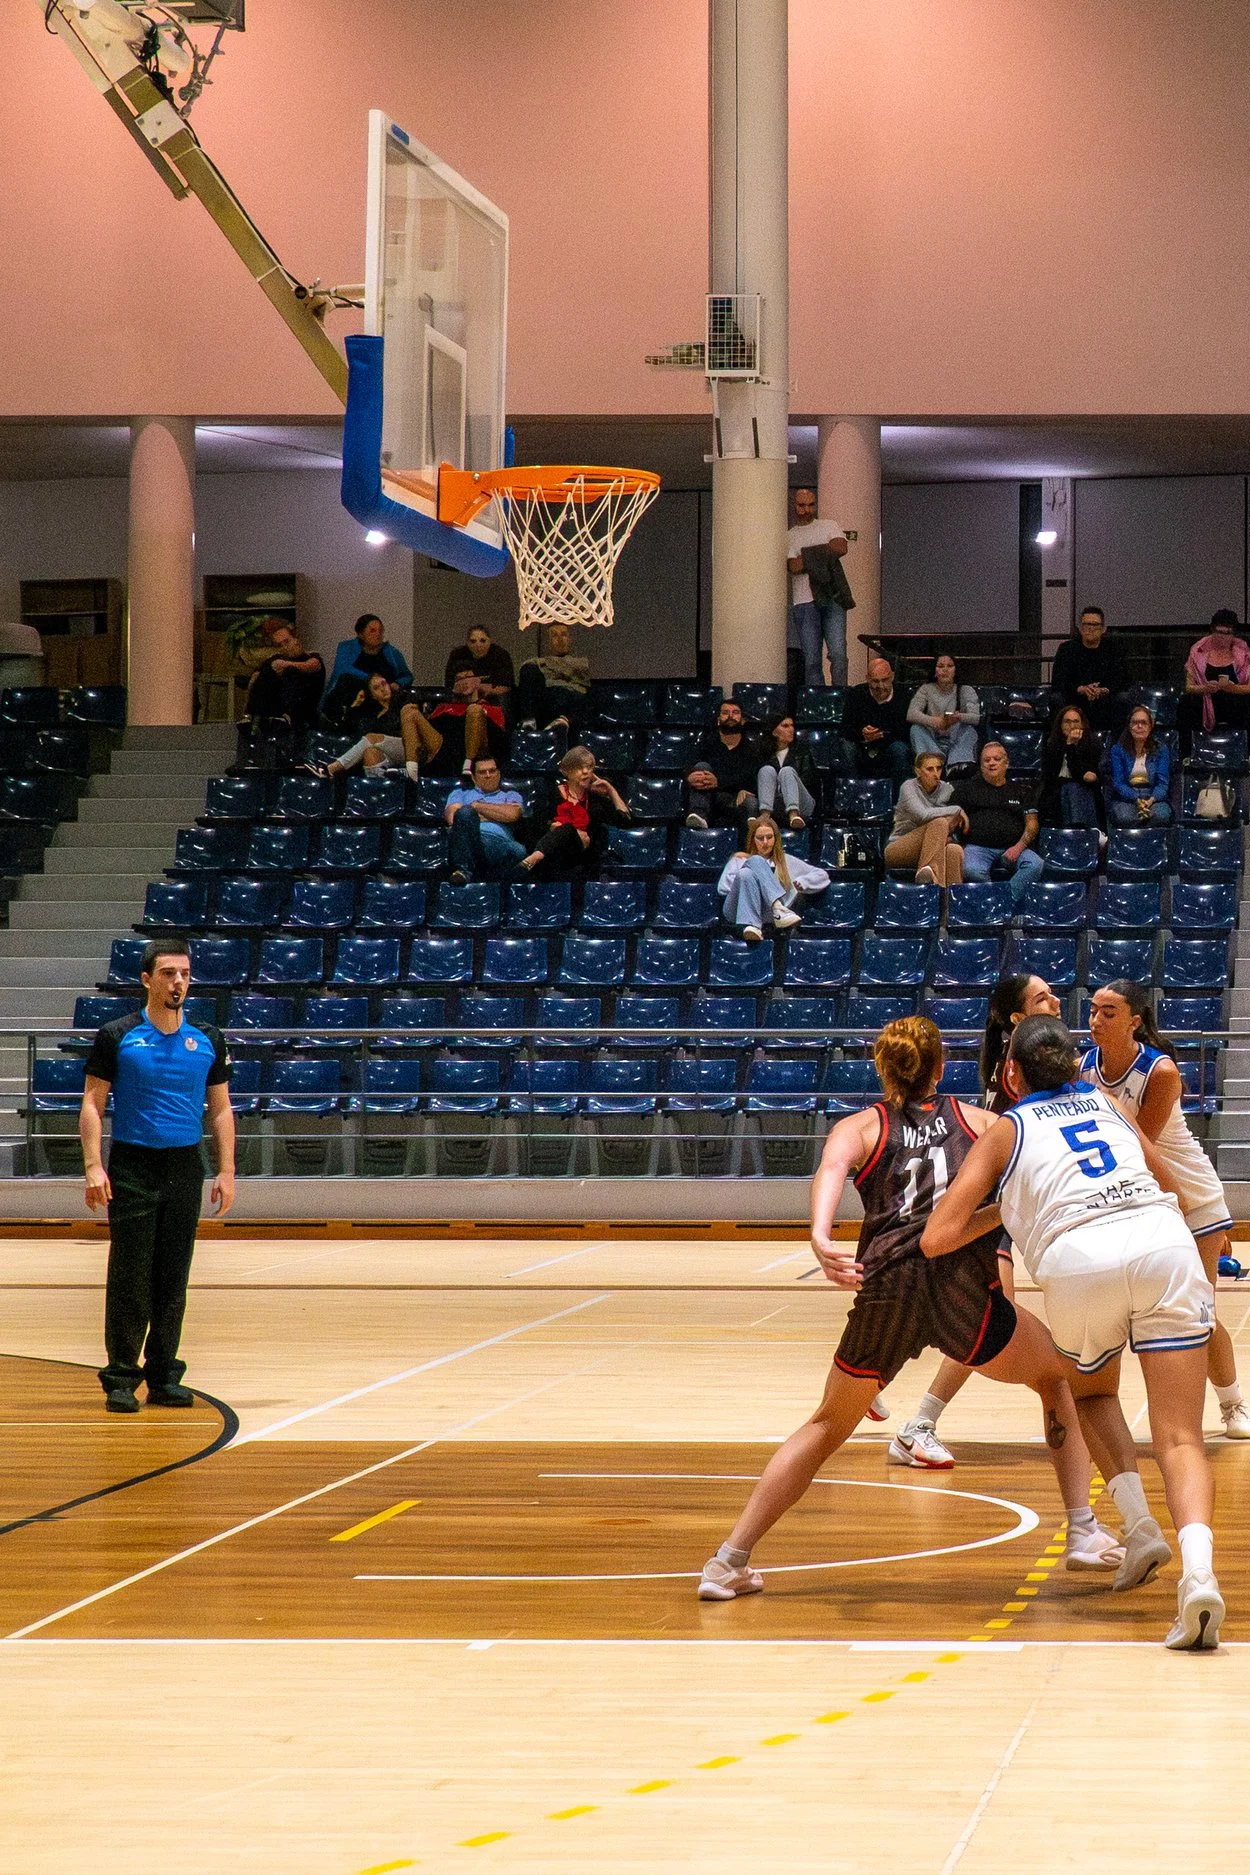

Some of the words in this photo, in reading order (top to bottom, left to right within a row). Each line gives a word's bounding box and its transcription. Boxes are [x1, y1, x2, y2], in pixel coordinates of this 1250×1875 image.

[1032, 1098, 1100, 1121] PENTEADO
[1059, 1119, 1118, 1178] 5
[899, 1146, 949, 1217] 11
